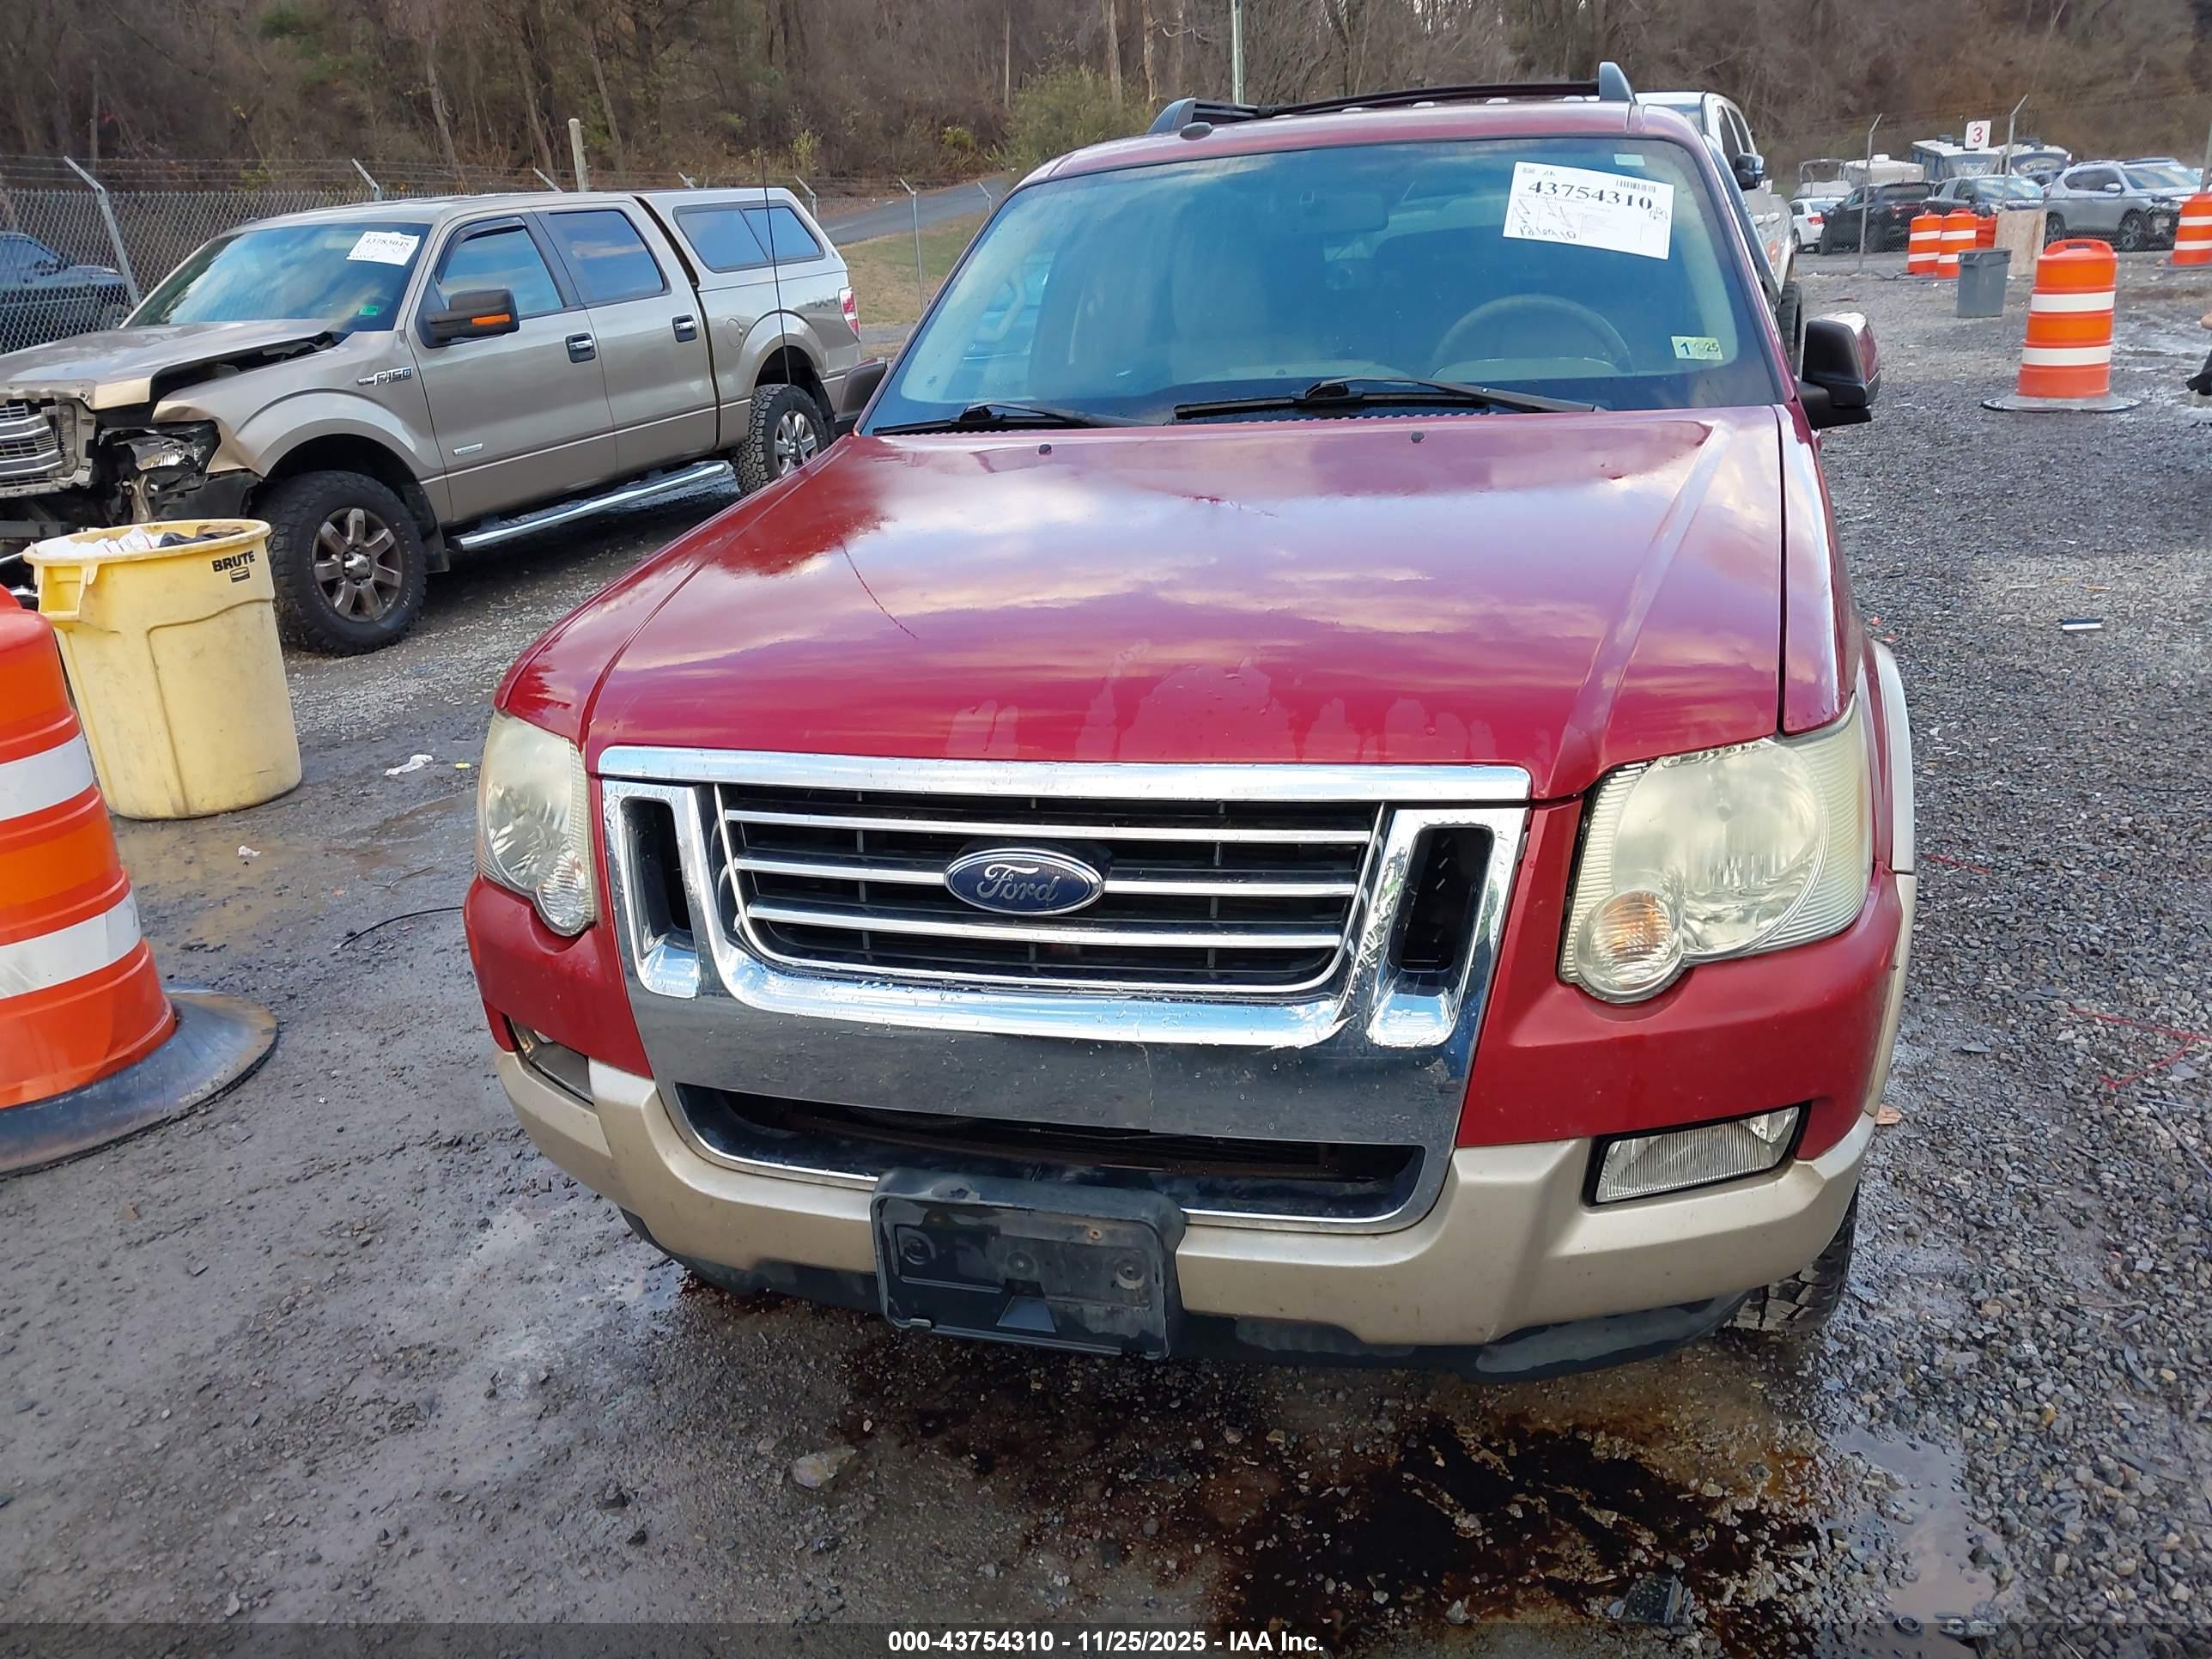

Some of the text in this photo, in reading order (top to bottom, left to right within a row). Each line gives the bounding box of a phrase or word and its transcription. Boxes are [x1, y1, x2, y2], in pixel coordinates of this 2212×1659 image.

[1972, 126, 1984, 143] 3
[1528, 180, 1653, 211] 43754310
[1704, 342, 1719, 353] 25
[211, 550, 256, 573] BRUTE
[976, 863, 1061, 902] Ford
